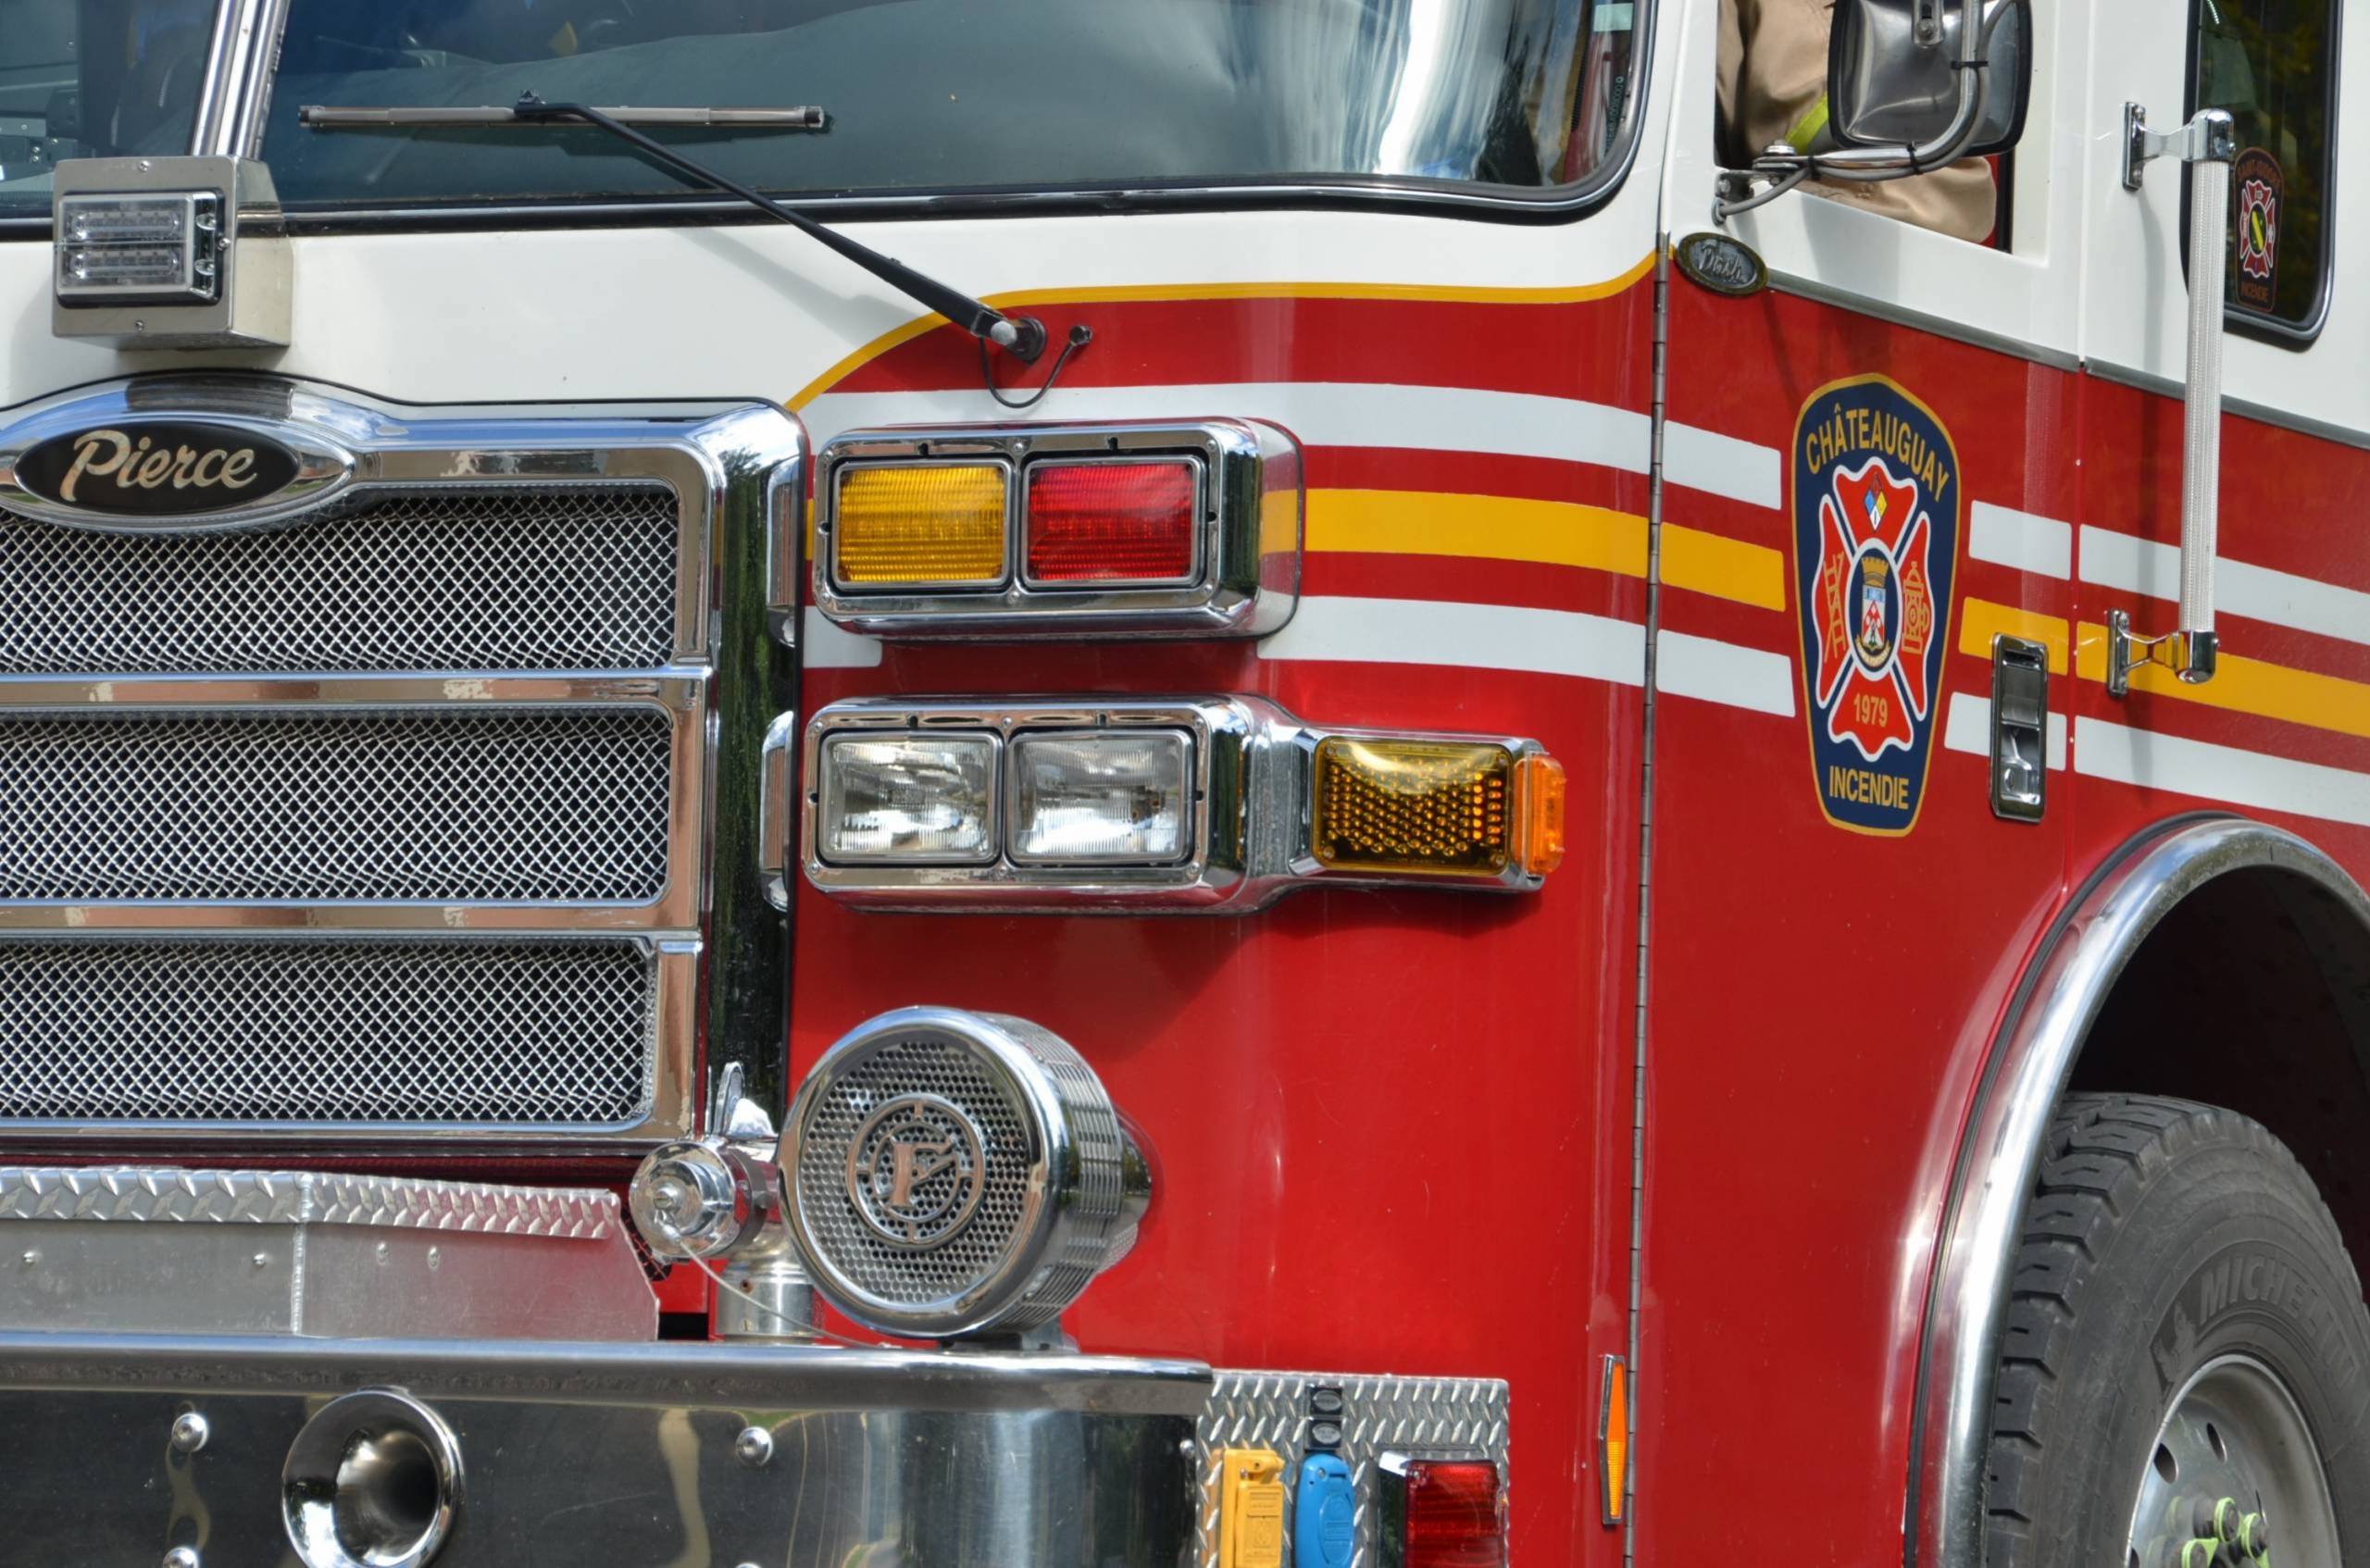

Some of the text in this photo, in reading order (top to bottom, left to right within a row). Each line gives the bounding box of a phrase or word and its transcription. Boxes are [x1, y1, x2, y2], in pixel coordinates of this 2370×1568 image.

[59, 429, 257, 502] Pierce
[1806, 403, 1950, 503] CHÂTEAUGUAY
[1853, 692, 1888, 728] 1979
[1829, 765, 1909, 810] INCENDIE
